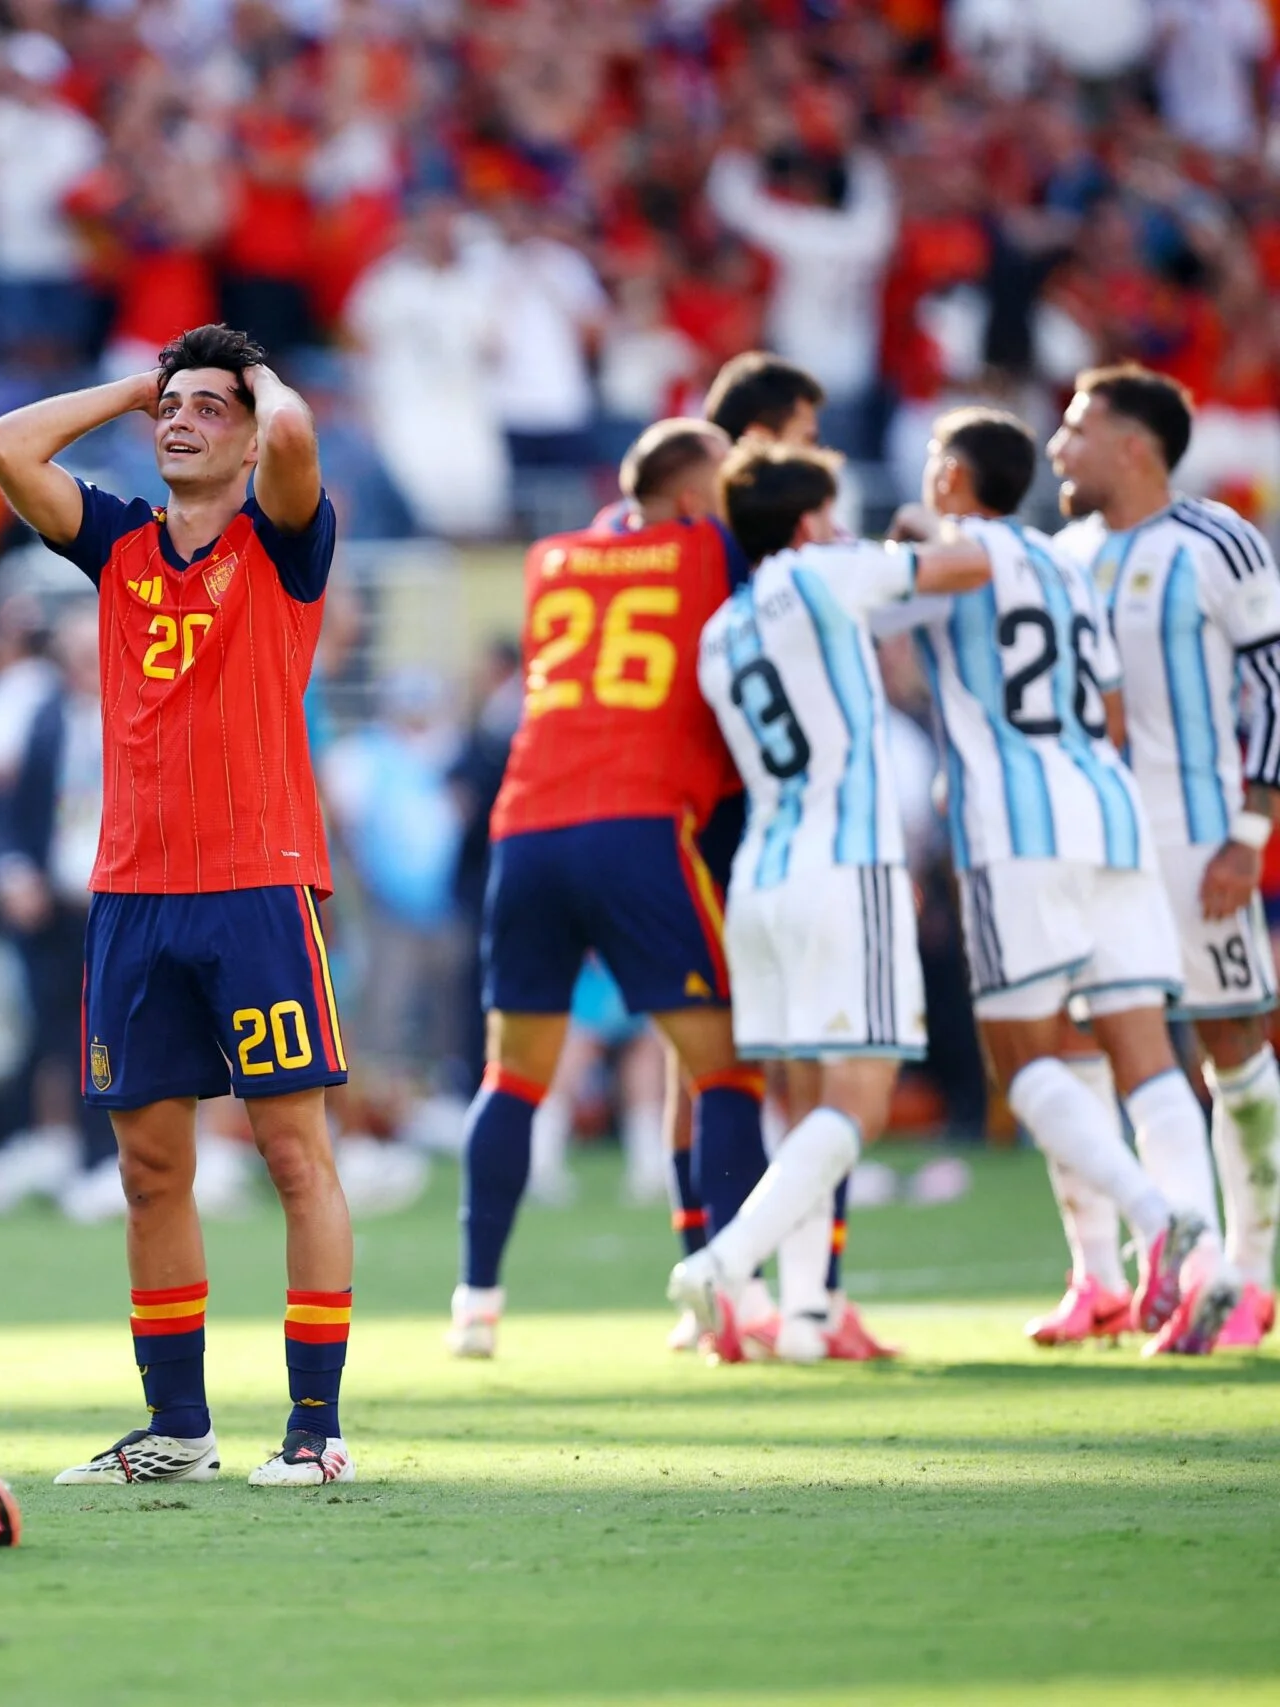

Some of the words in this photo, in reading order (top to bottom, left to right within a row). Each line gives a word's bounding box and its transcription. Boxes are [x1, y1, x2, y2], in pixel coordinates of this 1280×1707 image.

[143, 613, 214, 680] 20
[525, 586, 680, 718] 26
[1207, 935, 1252, 990] 19
[233, 1000, 312, 1075] 20
